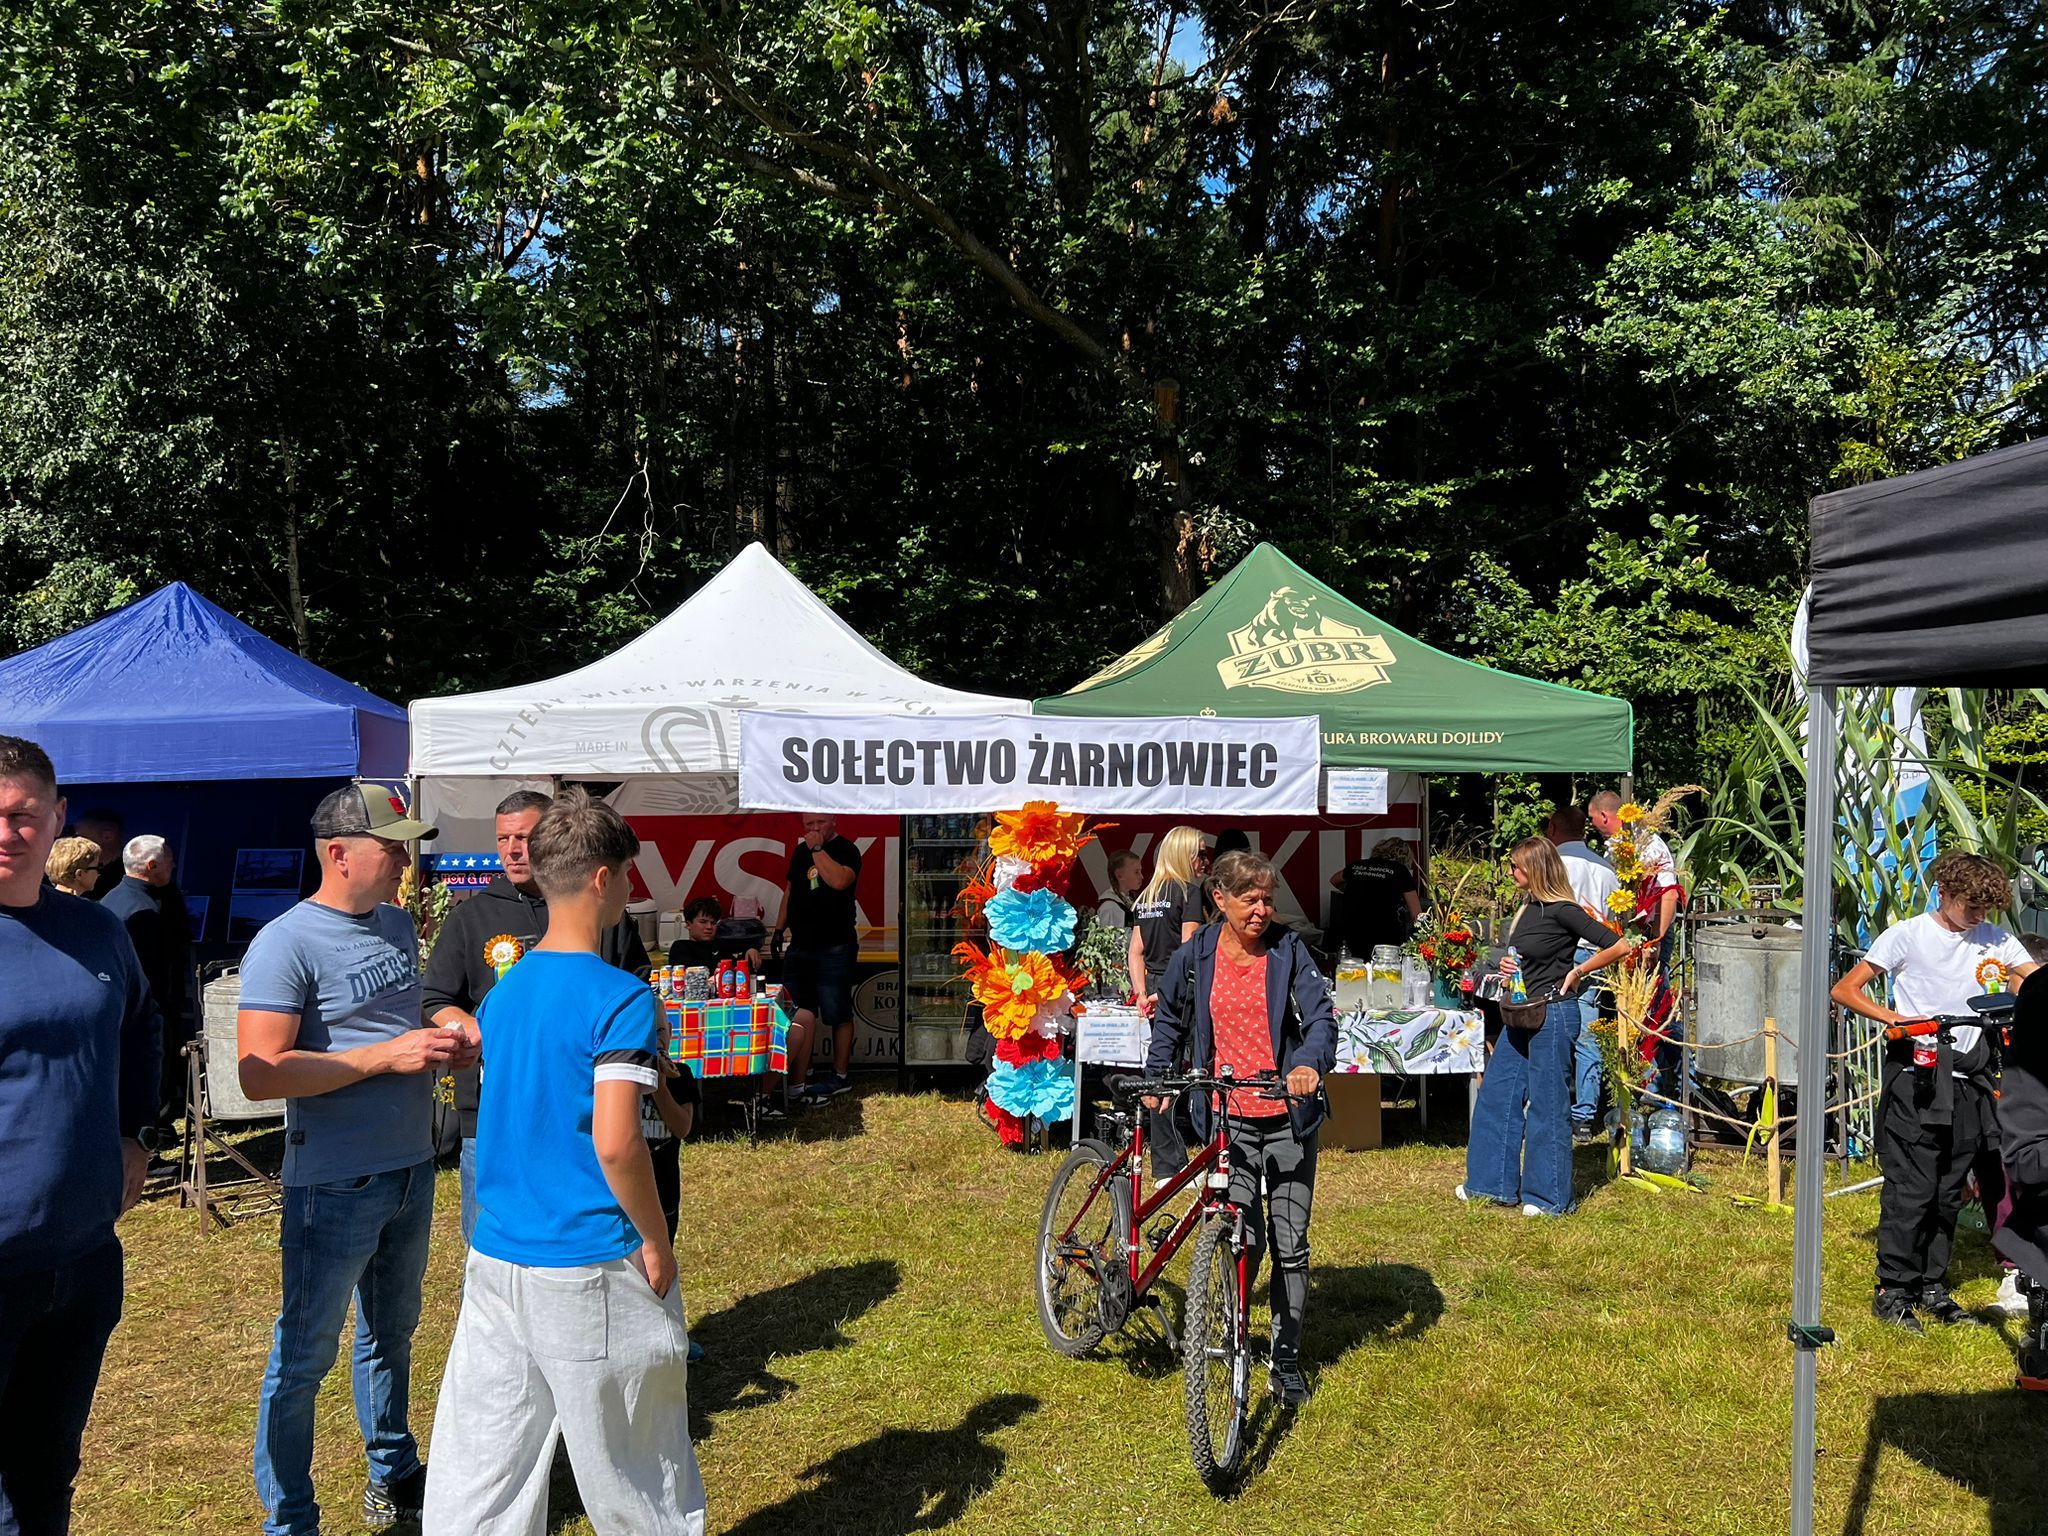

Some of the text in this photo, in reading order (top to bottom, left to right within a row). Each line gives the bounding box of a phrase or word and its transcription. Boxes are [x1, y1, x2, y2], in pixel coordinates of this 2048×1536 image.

[488, 696, 565, 771] CZTERY
[581, 683, 667, 699] WIEKI
[686, 678, 830, 694] WARZENIA
[1320, 731, 1504, 746] URA BROWARU DOJLIDY
[575, 741, 628, 753] MADE IN
[782, 733, 1278, 789] SOŁECTWO ŻARNOWIEC
[873, 996, 900, 1010] KO
